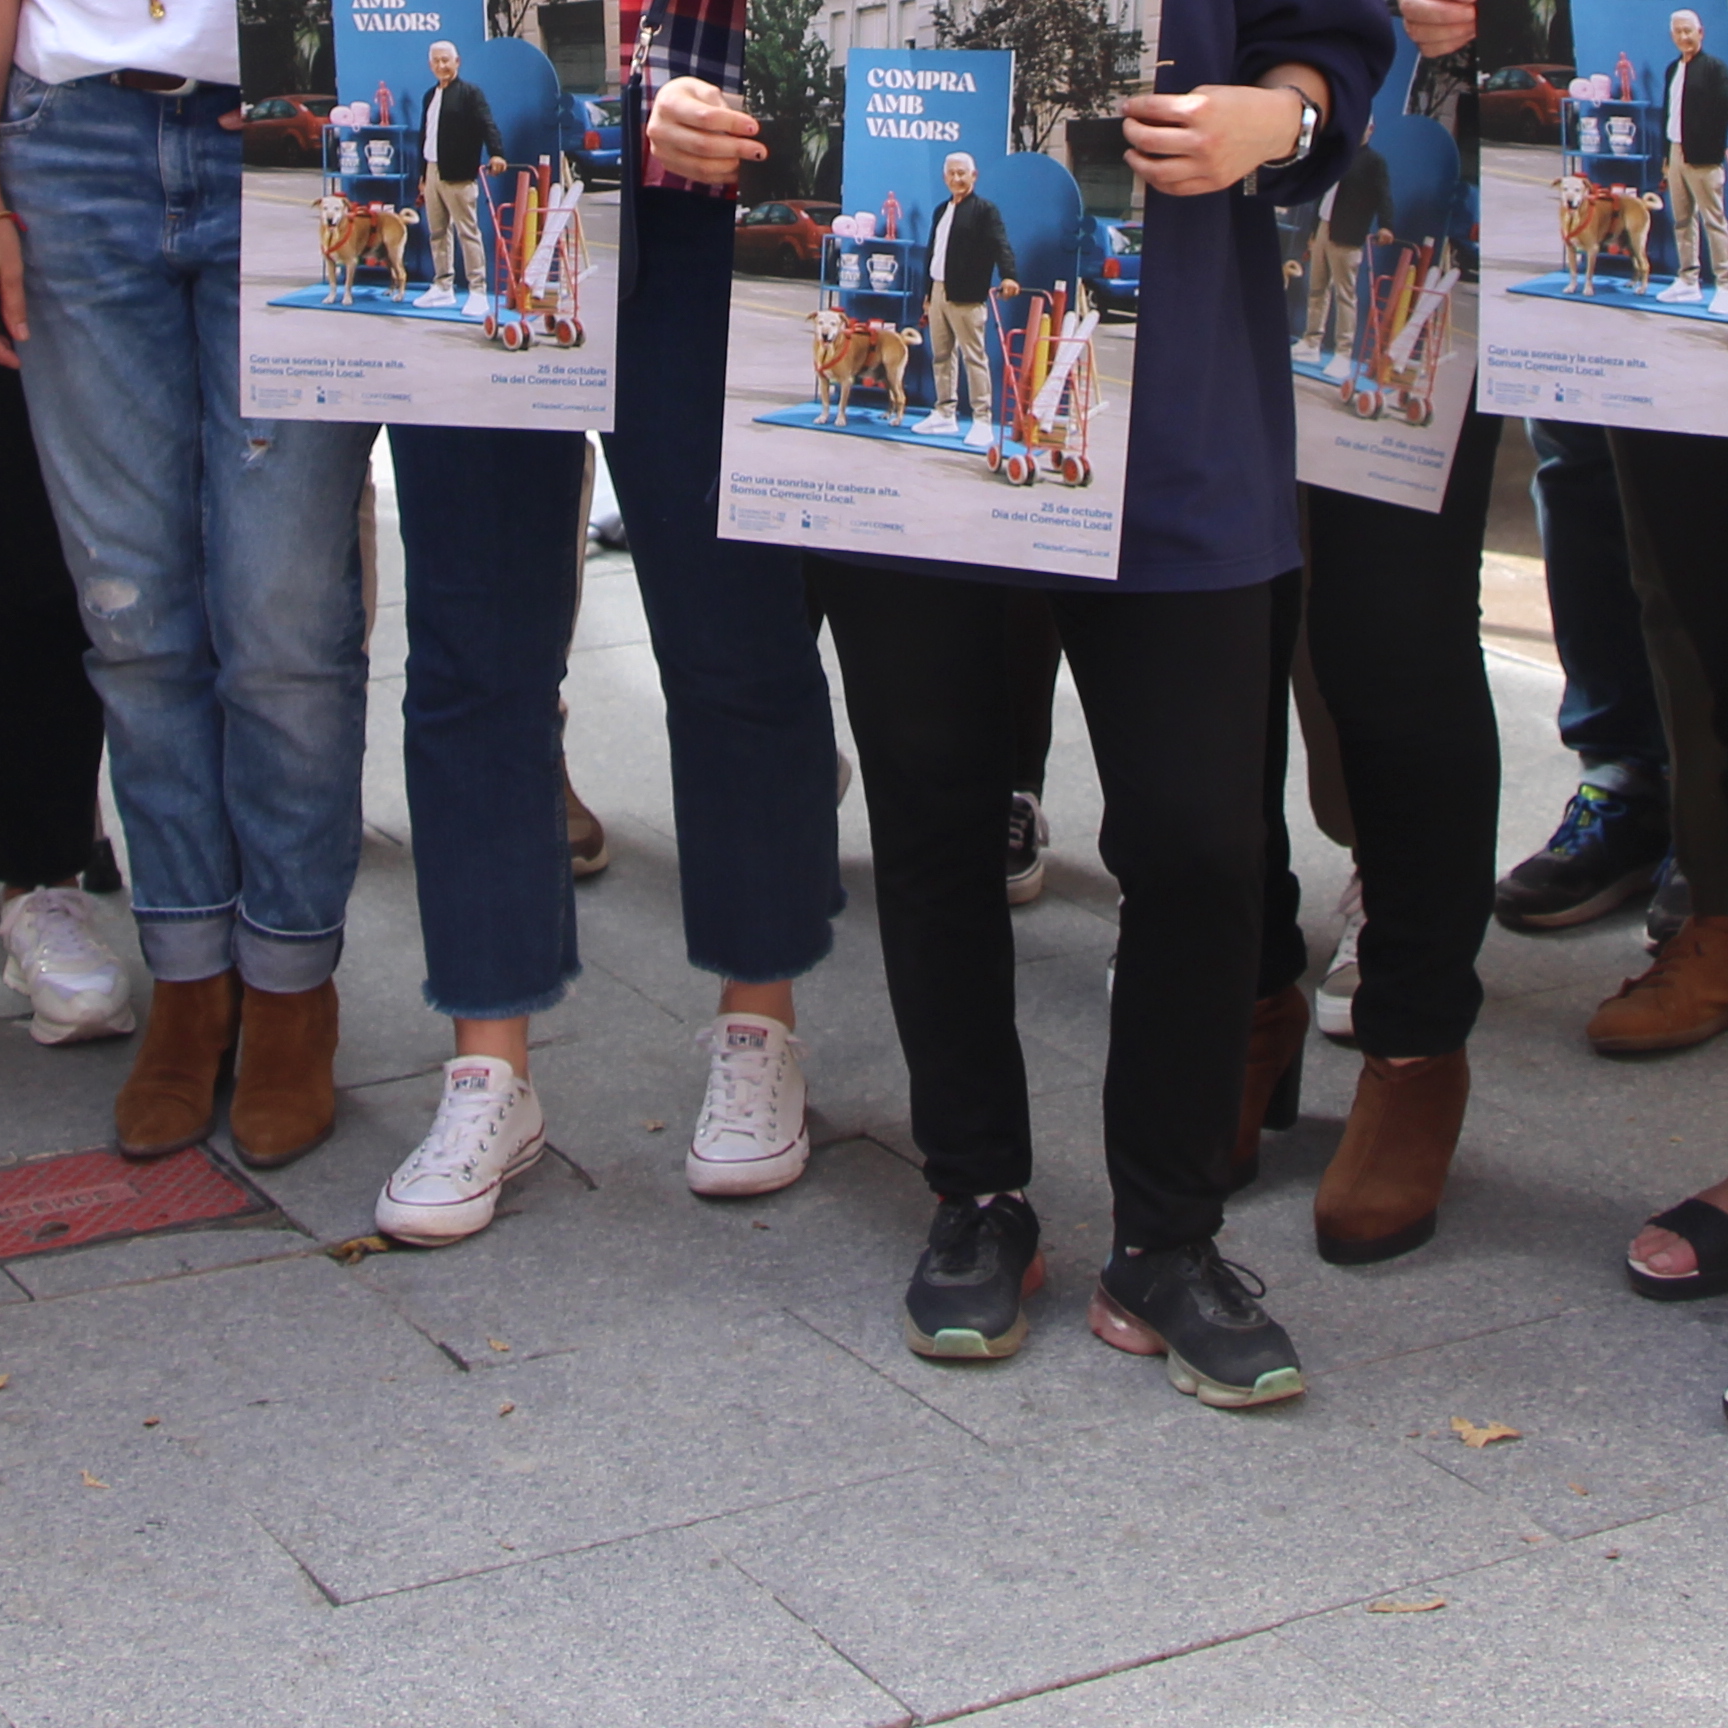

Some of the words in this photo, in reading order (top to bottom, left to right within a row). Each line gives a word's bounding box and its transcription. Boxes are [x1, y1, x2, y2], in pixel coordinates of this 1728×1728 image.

[352, 12, 441, 32] VALORS
[866, 67, 977, 92] COMPRA
[866, 92, 924, 115] AMB
[866, 117, 962, 142] VALORS
[286, 366, 334, 377] Comercio
[552, 365, 565, 374] de
[567, 366, 607, 376] octubre
[509, 375, 525, 384] del
[527, 375, 577, 386] Comercio
[579, 377, 607, 387] Local
[730, 472, 753, 483] Con
[755, 476, 774, 485] una
[776, 477, 816, 489] sonrisa
[837, 483, 876, 495] cabeza
[730, 484, 768, 497] Somos
[769, 488, 822, 502] Comercio
[1041, 502, 1054, 513] 25
[1056, 504, 1070, 514] de
[1072, 506, 1113, 519] octubre
[1011, 511, 1028, 522] del
[1030, 513, 1082, 528] Comercio
[1083, 519, 1112, 531] Local
